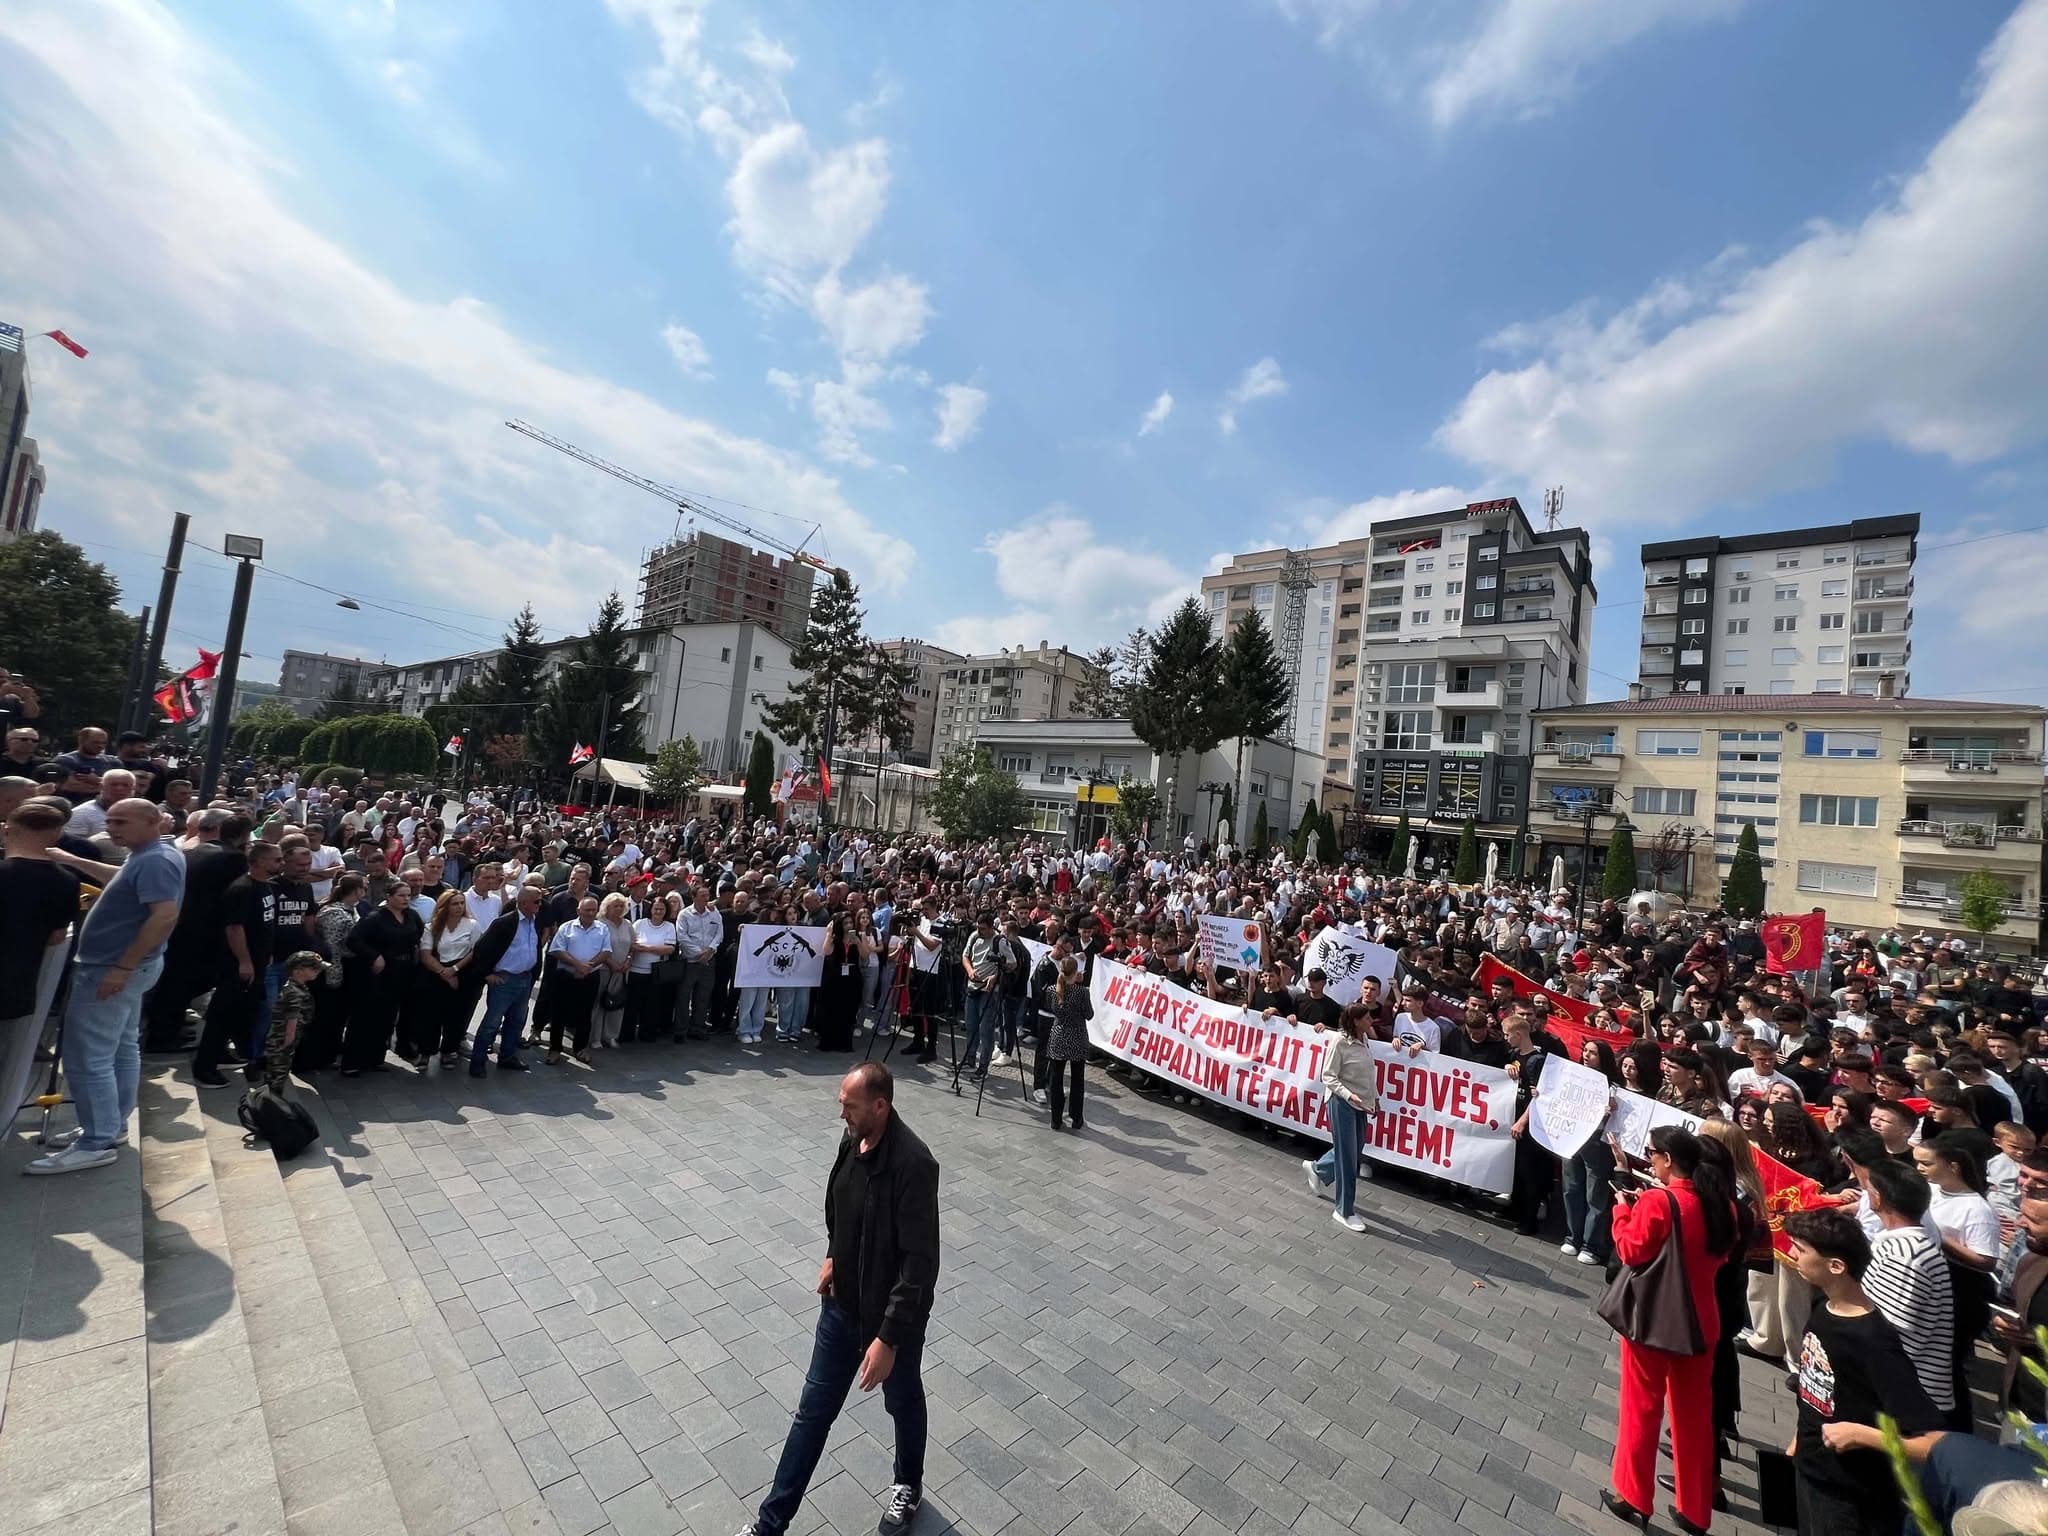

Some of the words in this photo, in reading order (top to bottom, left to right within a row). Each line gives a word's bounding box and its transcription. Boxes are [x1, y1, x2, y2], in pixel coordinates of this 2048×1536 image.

[1104, 975, 1132, 1007] NË
[1126, 983, 1168, 1024] EMËR
[1171, 1000, 1198, 1034] TË
[1190, 1013, 1304, 1074] POPULLIT
[1308, 1039, 1329, 1083] T
[1111, 1018, 1132, 1049] JU
[1131, 1026, 1230, 1096] SHPALLIM
[1236, 1065, 1266, 1108] TË
